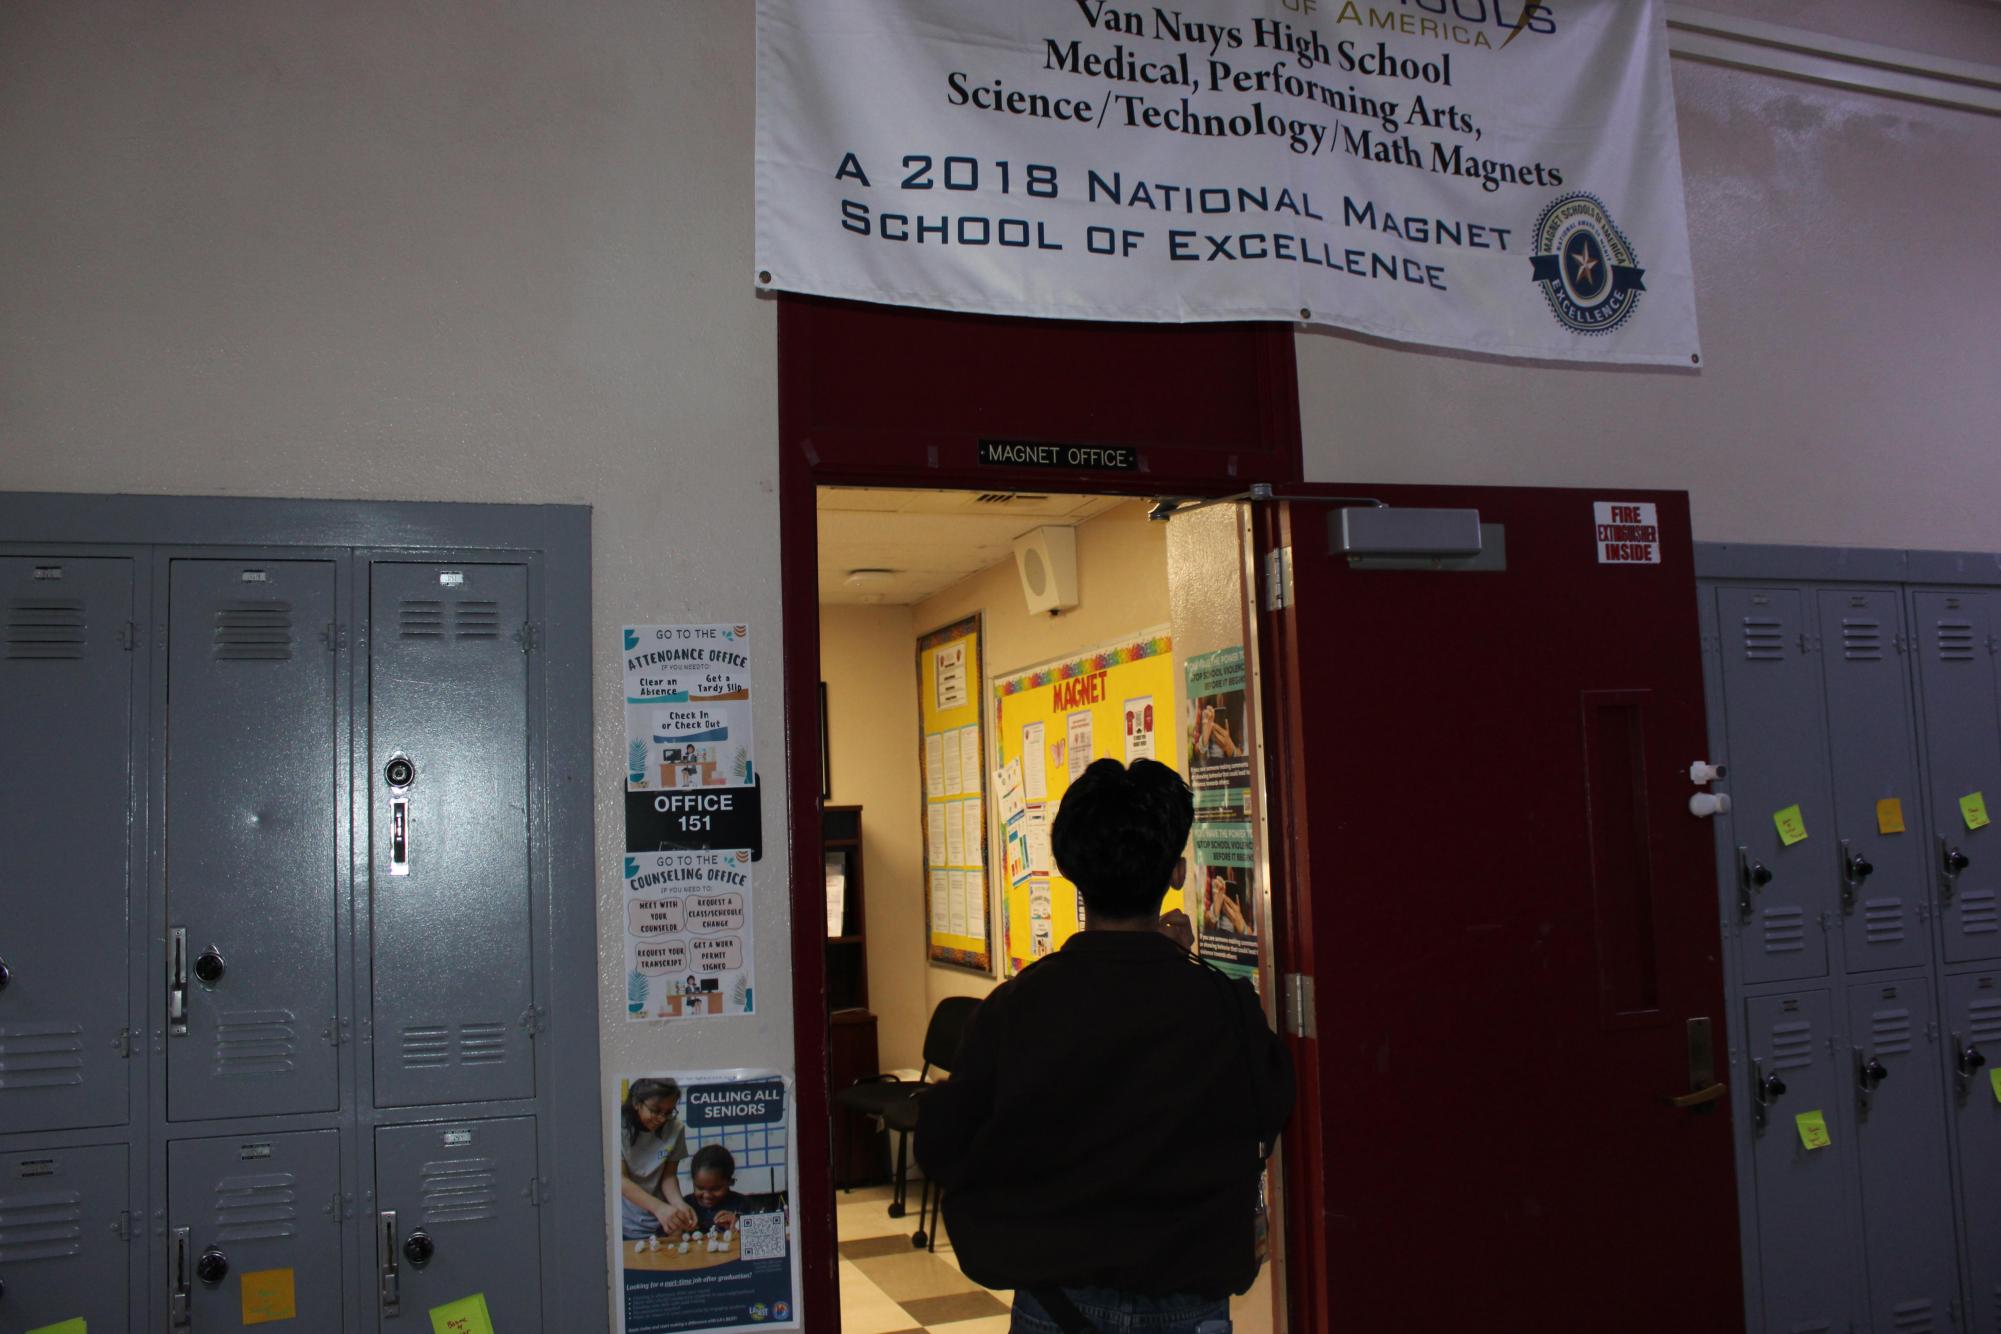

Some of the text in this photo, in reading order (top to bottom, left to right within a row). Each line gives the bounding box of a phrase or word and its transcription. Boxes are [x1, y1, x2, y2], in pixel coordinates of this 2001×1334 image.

[1336, 0, 1492, 50] AMERICA
[1076, 0, 1452, 86] Van Nuys High School
[1042, 38, 1482, 141] Medical, Performing Arts,
[1430, 142, 1563, 192] Magnets
[835, 152, 1512, 250] A 2018 NATIONAL MAGNET
[1543, 215, 1563, 252] MAGNET
[1561, 203, 1595, 219] SCHOOLS
[1601, 223, 1626, 265] AMERICA
[841, 199, 1447, 291] SCHOOL OF EXCELLENCE
[1552, 278, 1625, 323] EXCELLENCE
[988, 443, 1129, 467] MAGNET OFFICE
[1611, 506, 1642, 524] FIRE
[1597, 524, 1657, 543] EXTINGUISHER
[1605, 543, 1652, 561] INSIDE
[656, 628, 718, 640] GO TO THE
[628, 648, 748, 671] ATTENDANCE OFFICE
[639, 677, 678, 687] Clear an
[705, 674, 722, 683] Get
[640, 686, 678, 696] Absence
[697, 683, 743, 694] Tardy Slip
[1053, 671, 1107, 713] MAGNET
[669, 710, 709, 720] Check In
[662, 720, 721, 729] or Check Out
[654, 795, 733, 812] OFFICE
[677, 815, 712, 831] 151
[1197, 840, 1210, 848] STOP
[1211, 841, 1231, 849] SCHOOL
[657, 855, 718, 866] GO TO THE
[1213, 852, 1231, 861] BEFORE
[630, 868, 747, 891] COUNSELING OFFICE
[640, 901, 658, 909] MEET
[650, 913, 667, 921] YOUR
[688, 908, 742, 918] CLASS/SCHEDULE
[640, 924, 678, 933] COUNSELOR
[702, 920, 729, 928] CHANGE
[693, 940, 734, 949] GET A WORK
[637, 948, 685, 957] REQUEST YOUR
[701, 952, 726, 960] PERMIT
[641, 959, 682, 969] TRANSCRIPT
[702, 963, 727, 971] SIGNED
[690, 1089, 780, 1105] CALLING ALL
[704, 1104, 765, 1119] SENIORS
[626, 1282, 650, 1291] Looking
[651, 1281, 659, 1289] for
[692, 1276, 702, 1285] job
[703, 1275, 717, 1283] after
[718, 1272, 753, 1282] graduation?
